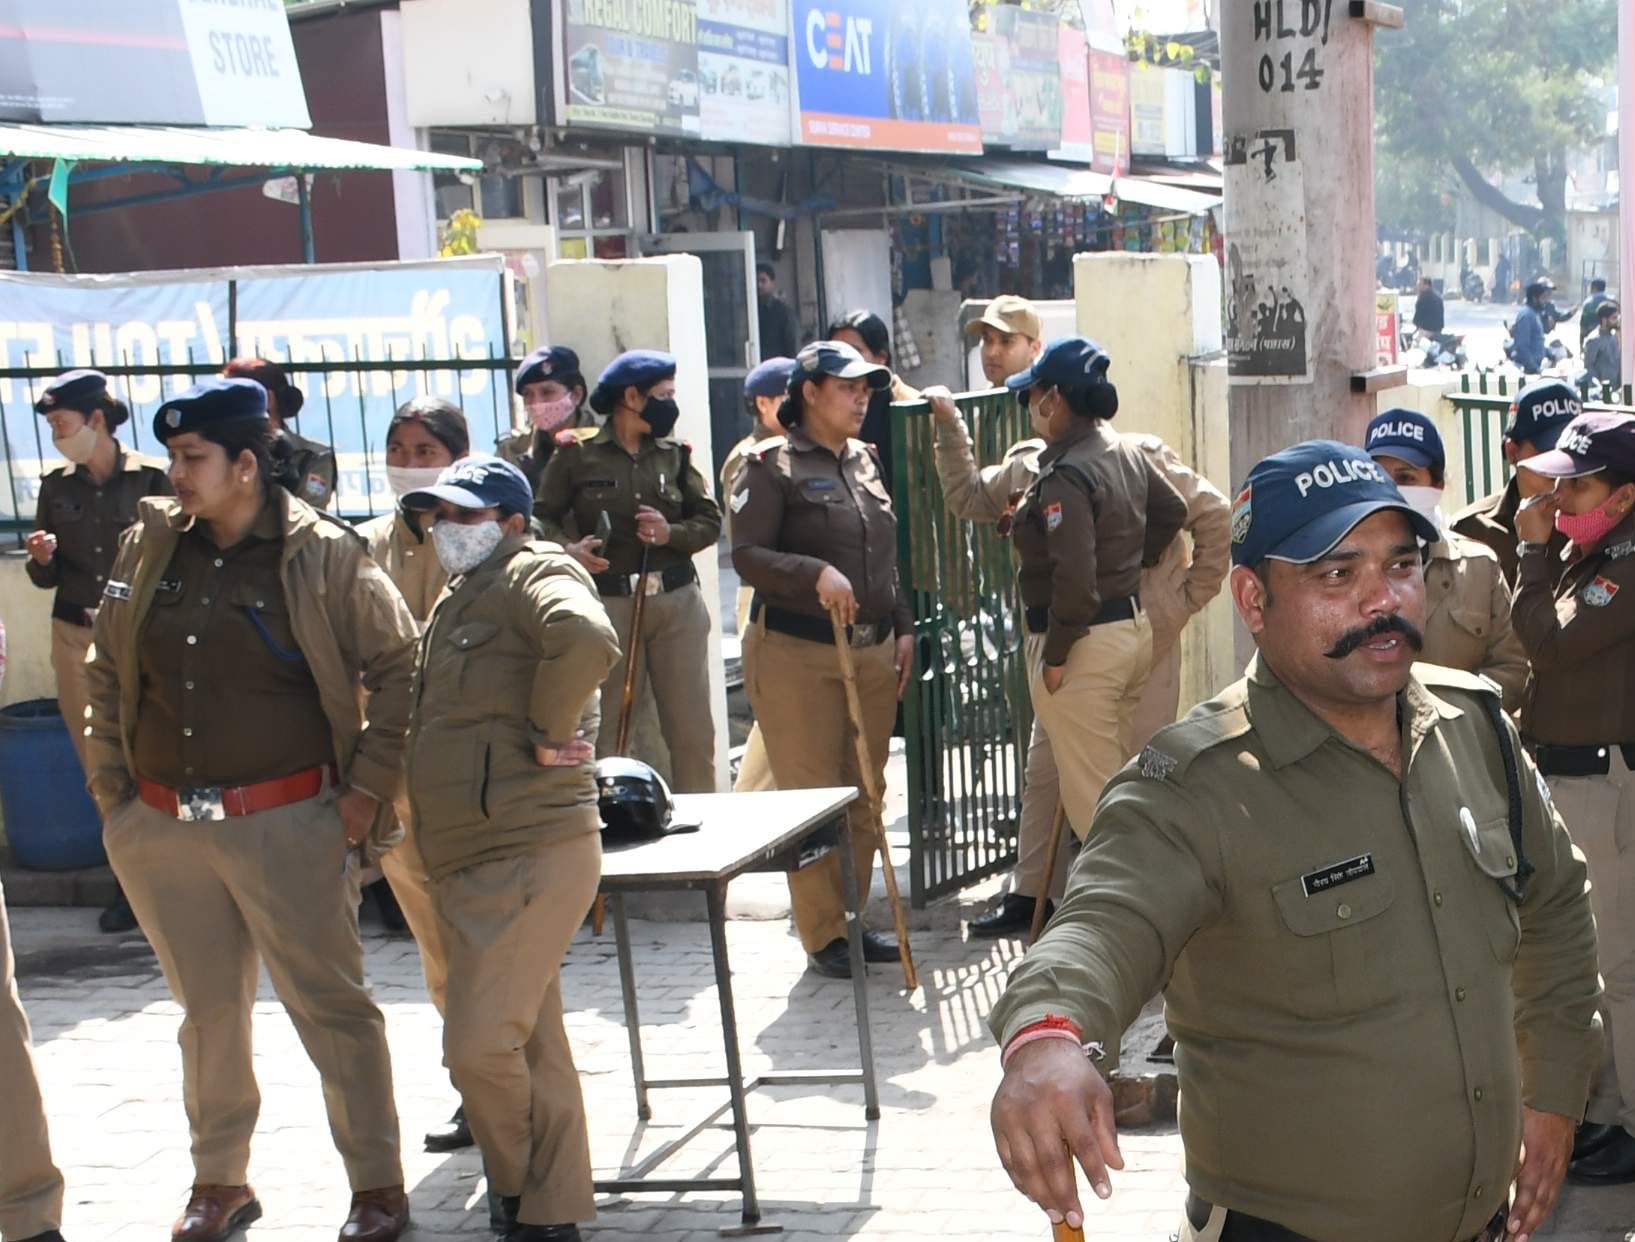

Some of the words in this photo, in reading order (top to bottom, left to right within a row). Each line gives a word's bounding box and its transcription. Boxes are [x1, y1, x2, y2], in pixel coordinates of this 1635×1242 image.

[633, 0, 697, 43] COMFORT
[806, 8, 872, 75] CEAT
[209, 31, 280, 78] STORE
[1259, 48, 1324, 93] 014
[1370, 421, 1424, 443] POLICE
[1294, 459, 1385, 498] POLICE
